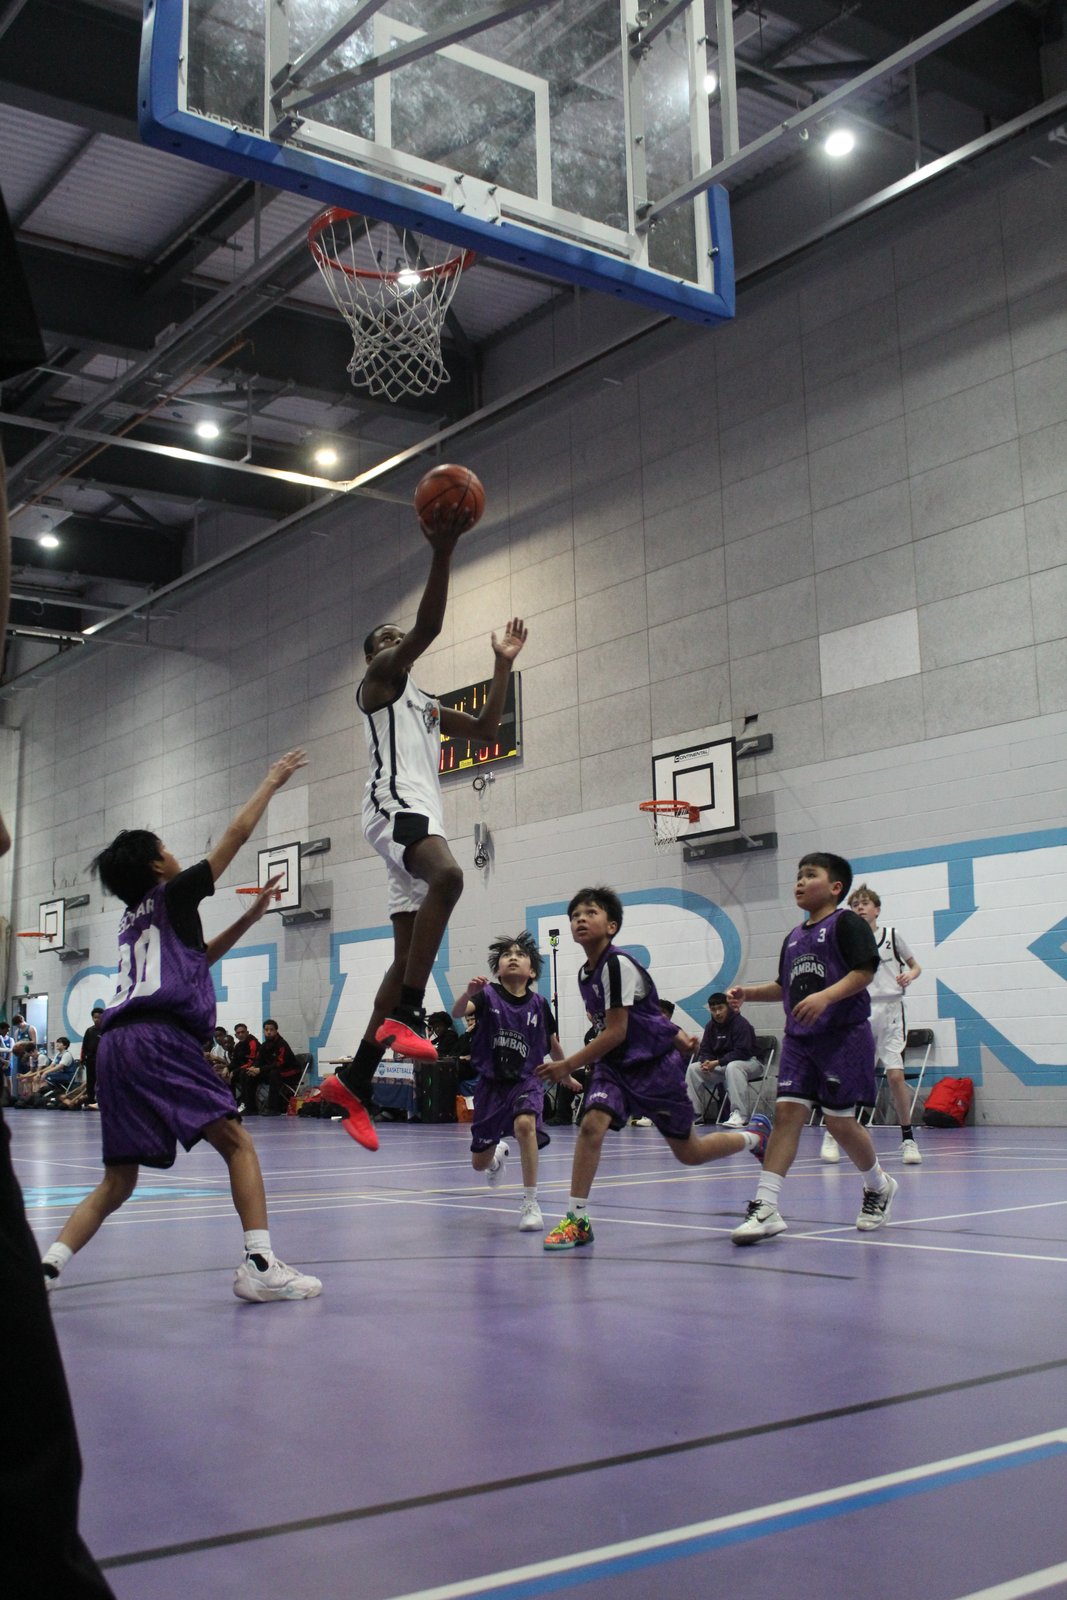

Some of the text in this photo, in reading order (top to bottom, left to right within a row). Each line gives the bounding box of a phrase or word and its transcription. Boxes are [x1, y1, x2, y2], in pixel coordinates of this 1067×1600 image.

[817, 928, 827, 943] 3
[885, 940, 892, 950] 2
[526, 1011, 538, 1028] 14
